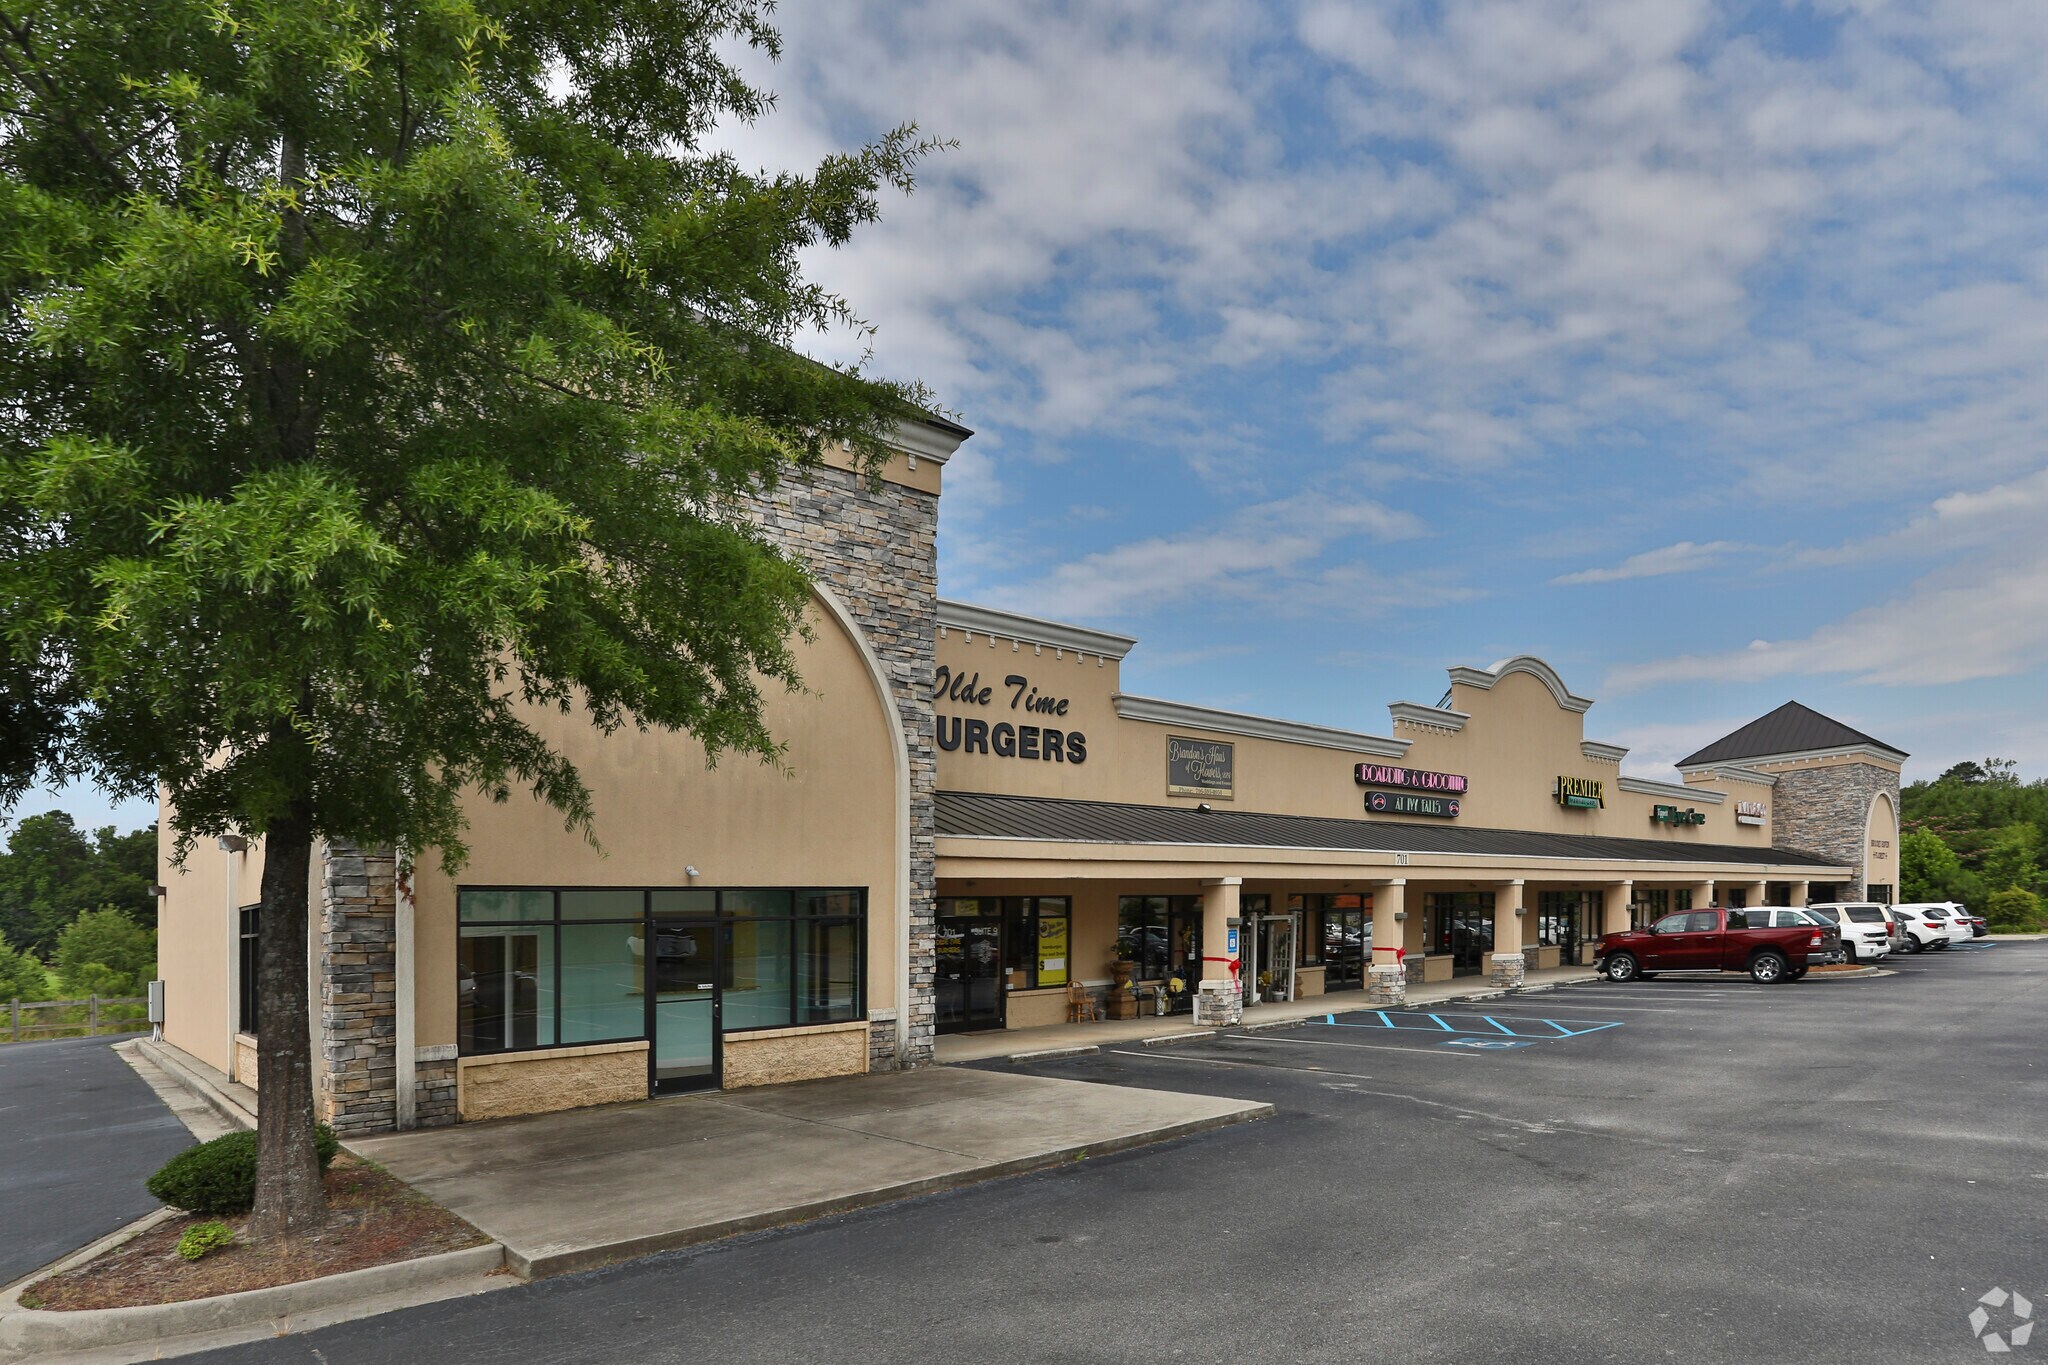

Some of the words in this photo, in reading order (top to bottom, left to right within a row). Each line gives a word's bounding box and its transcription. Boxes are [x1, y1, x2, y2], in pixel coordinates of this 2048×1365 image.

[933, 665, 993, 705] Olde
[1005, 674, 1070, 716] Time
[936, 715, 1087, 764] URGERS
[1362, 764, 1410, 786] BOARDING
[1421, 771, 1469, 793] GROOMING
[1558, 776, 1606, 809] PREMIER
[1395, 797, 1404, 811] AT
[1396, 854, 1408, 864] 701
